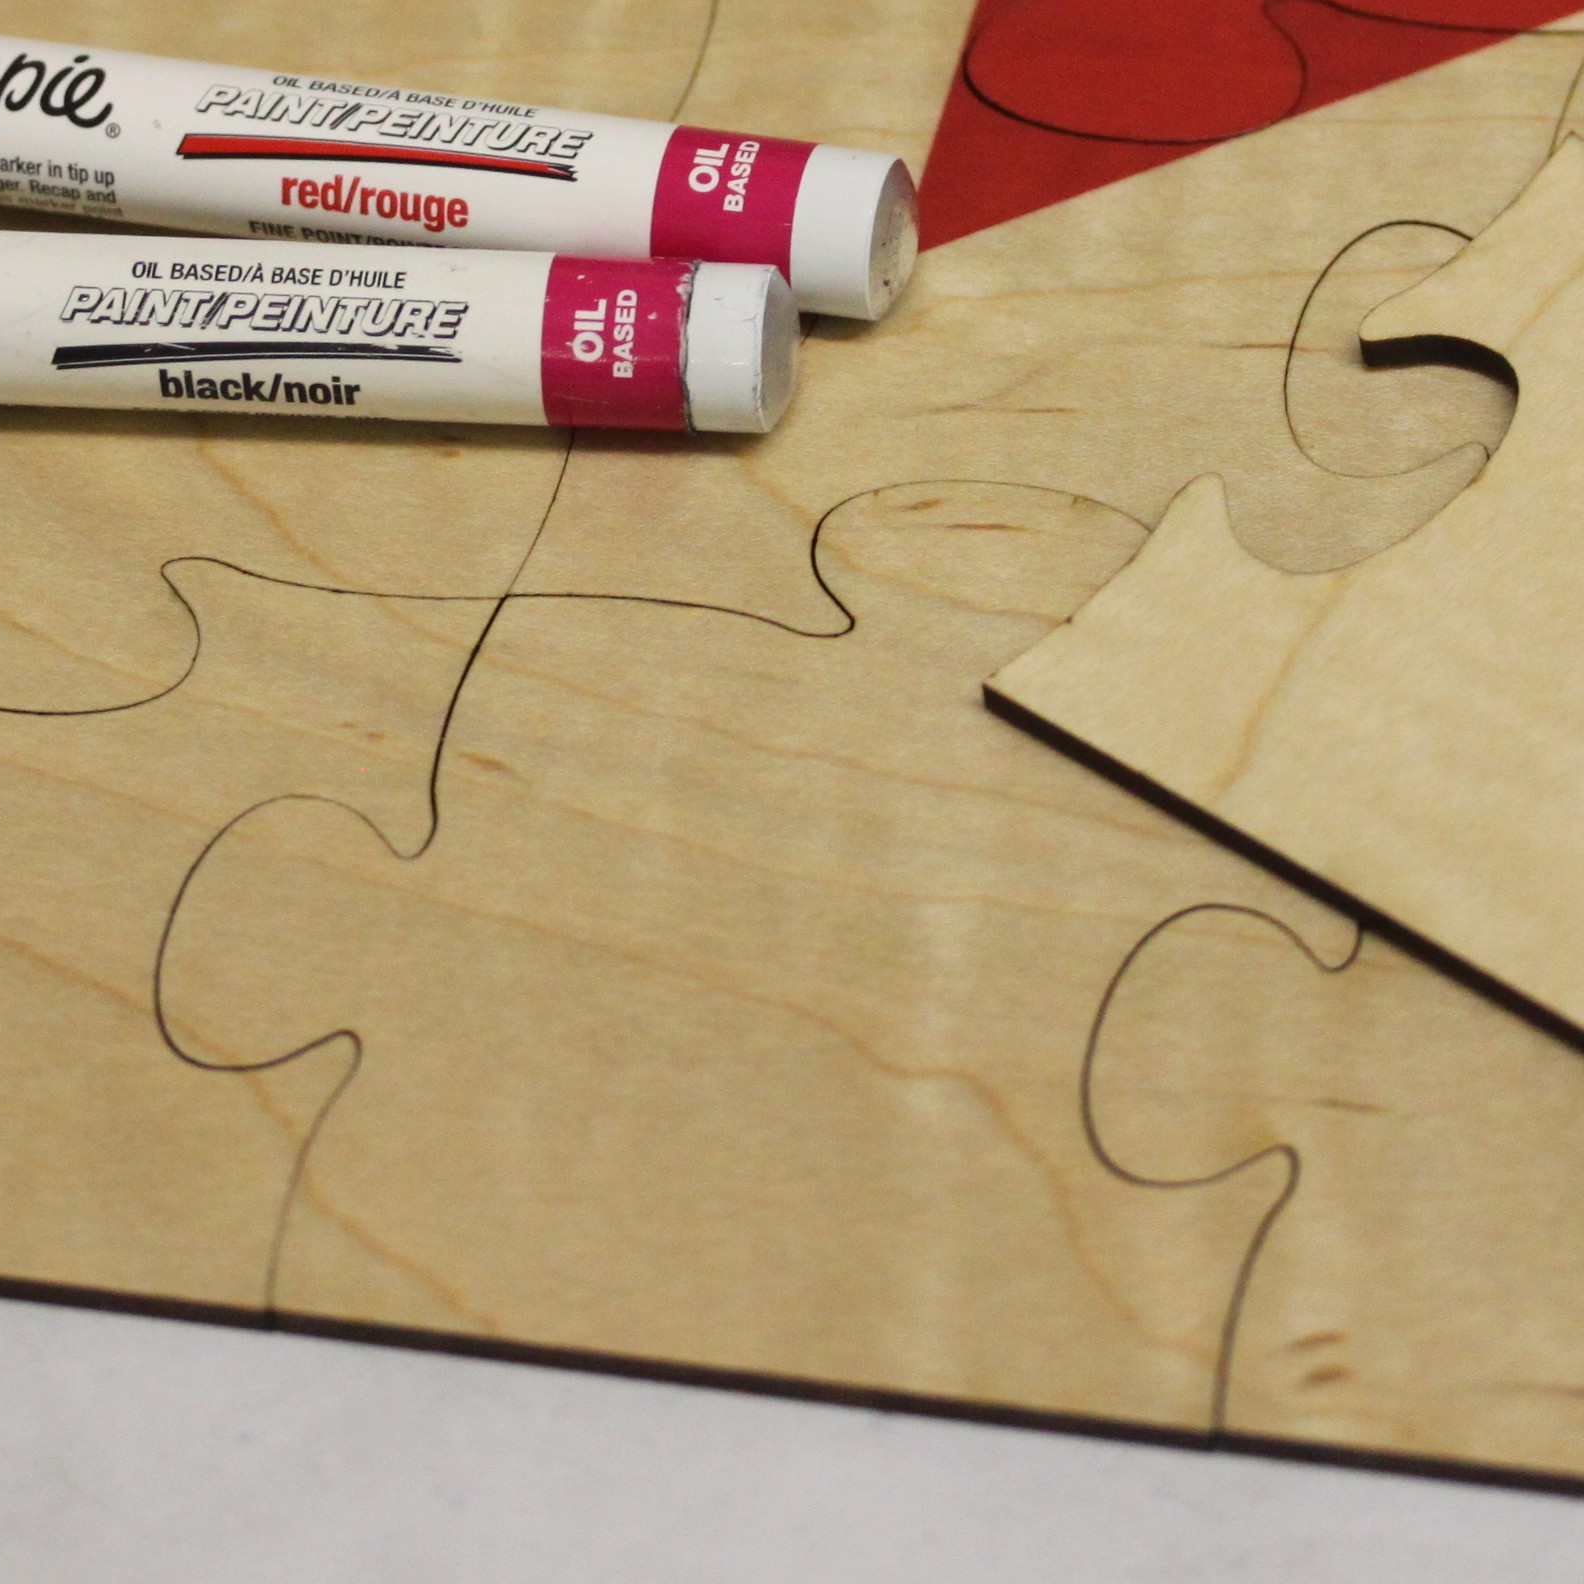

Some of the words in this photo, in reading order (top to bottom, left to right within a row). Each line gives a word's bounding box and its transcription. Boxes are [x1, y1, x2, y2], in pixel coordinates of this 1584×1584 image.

[272, 75, 302, 89] OIL
[407, 92, 459, 109] BASE
[195, 83, 594, 160] PAINT/PEINTURE
[29, 178, 81, 200] Recap
[86, 188, 117, 205] and
[47, 160, 63, 179] in
[68, 164, 92, 187] tip
[94, 170, 116, 190] up
[688, 142, 731, 193] OIL
[723, 140, 760, 213] BASED
[280, 174, 470, 233] red/rouge
[247, 219, 296, 241] FINE
[131, 260, 163, 280] OIL
[170, 261, 265, 284] BASED/À
[270, 266, 324, 286] BASE
[329, 268, 408, 290] D'HUILE
[58, 285, 470, 339] PAINT/PEINTURE
[572, 298, 608, 363] OIL
[612, 288, 639, 379] BASED
[158, 368, 362, 407] black/noir
